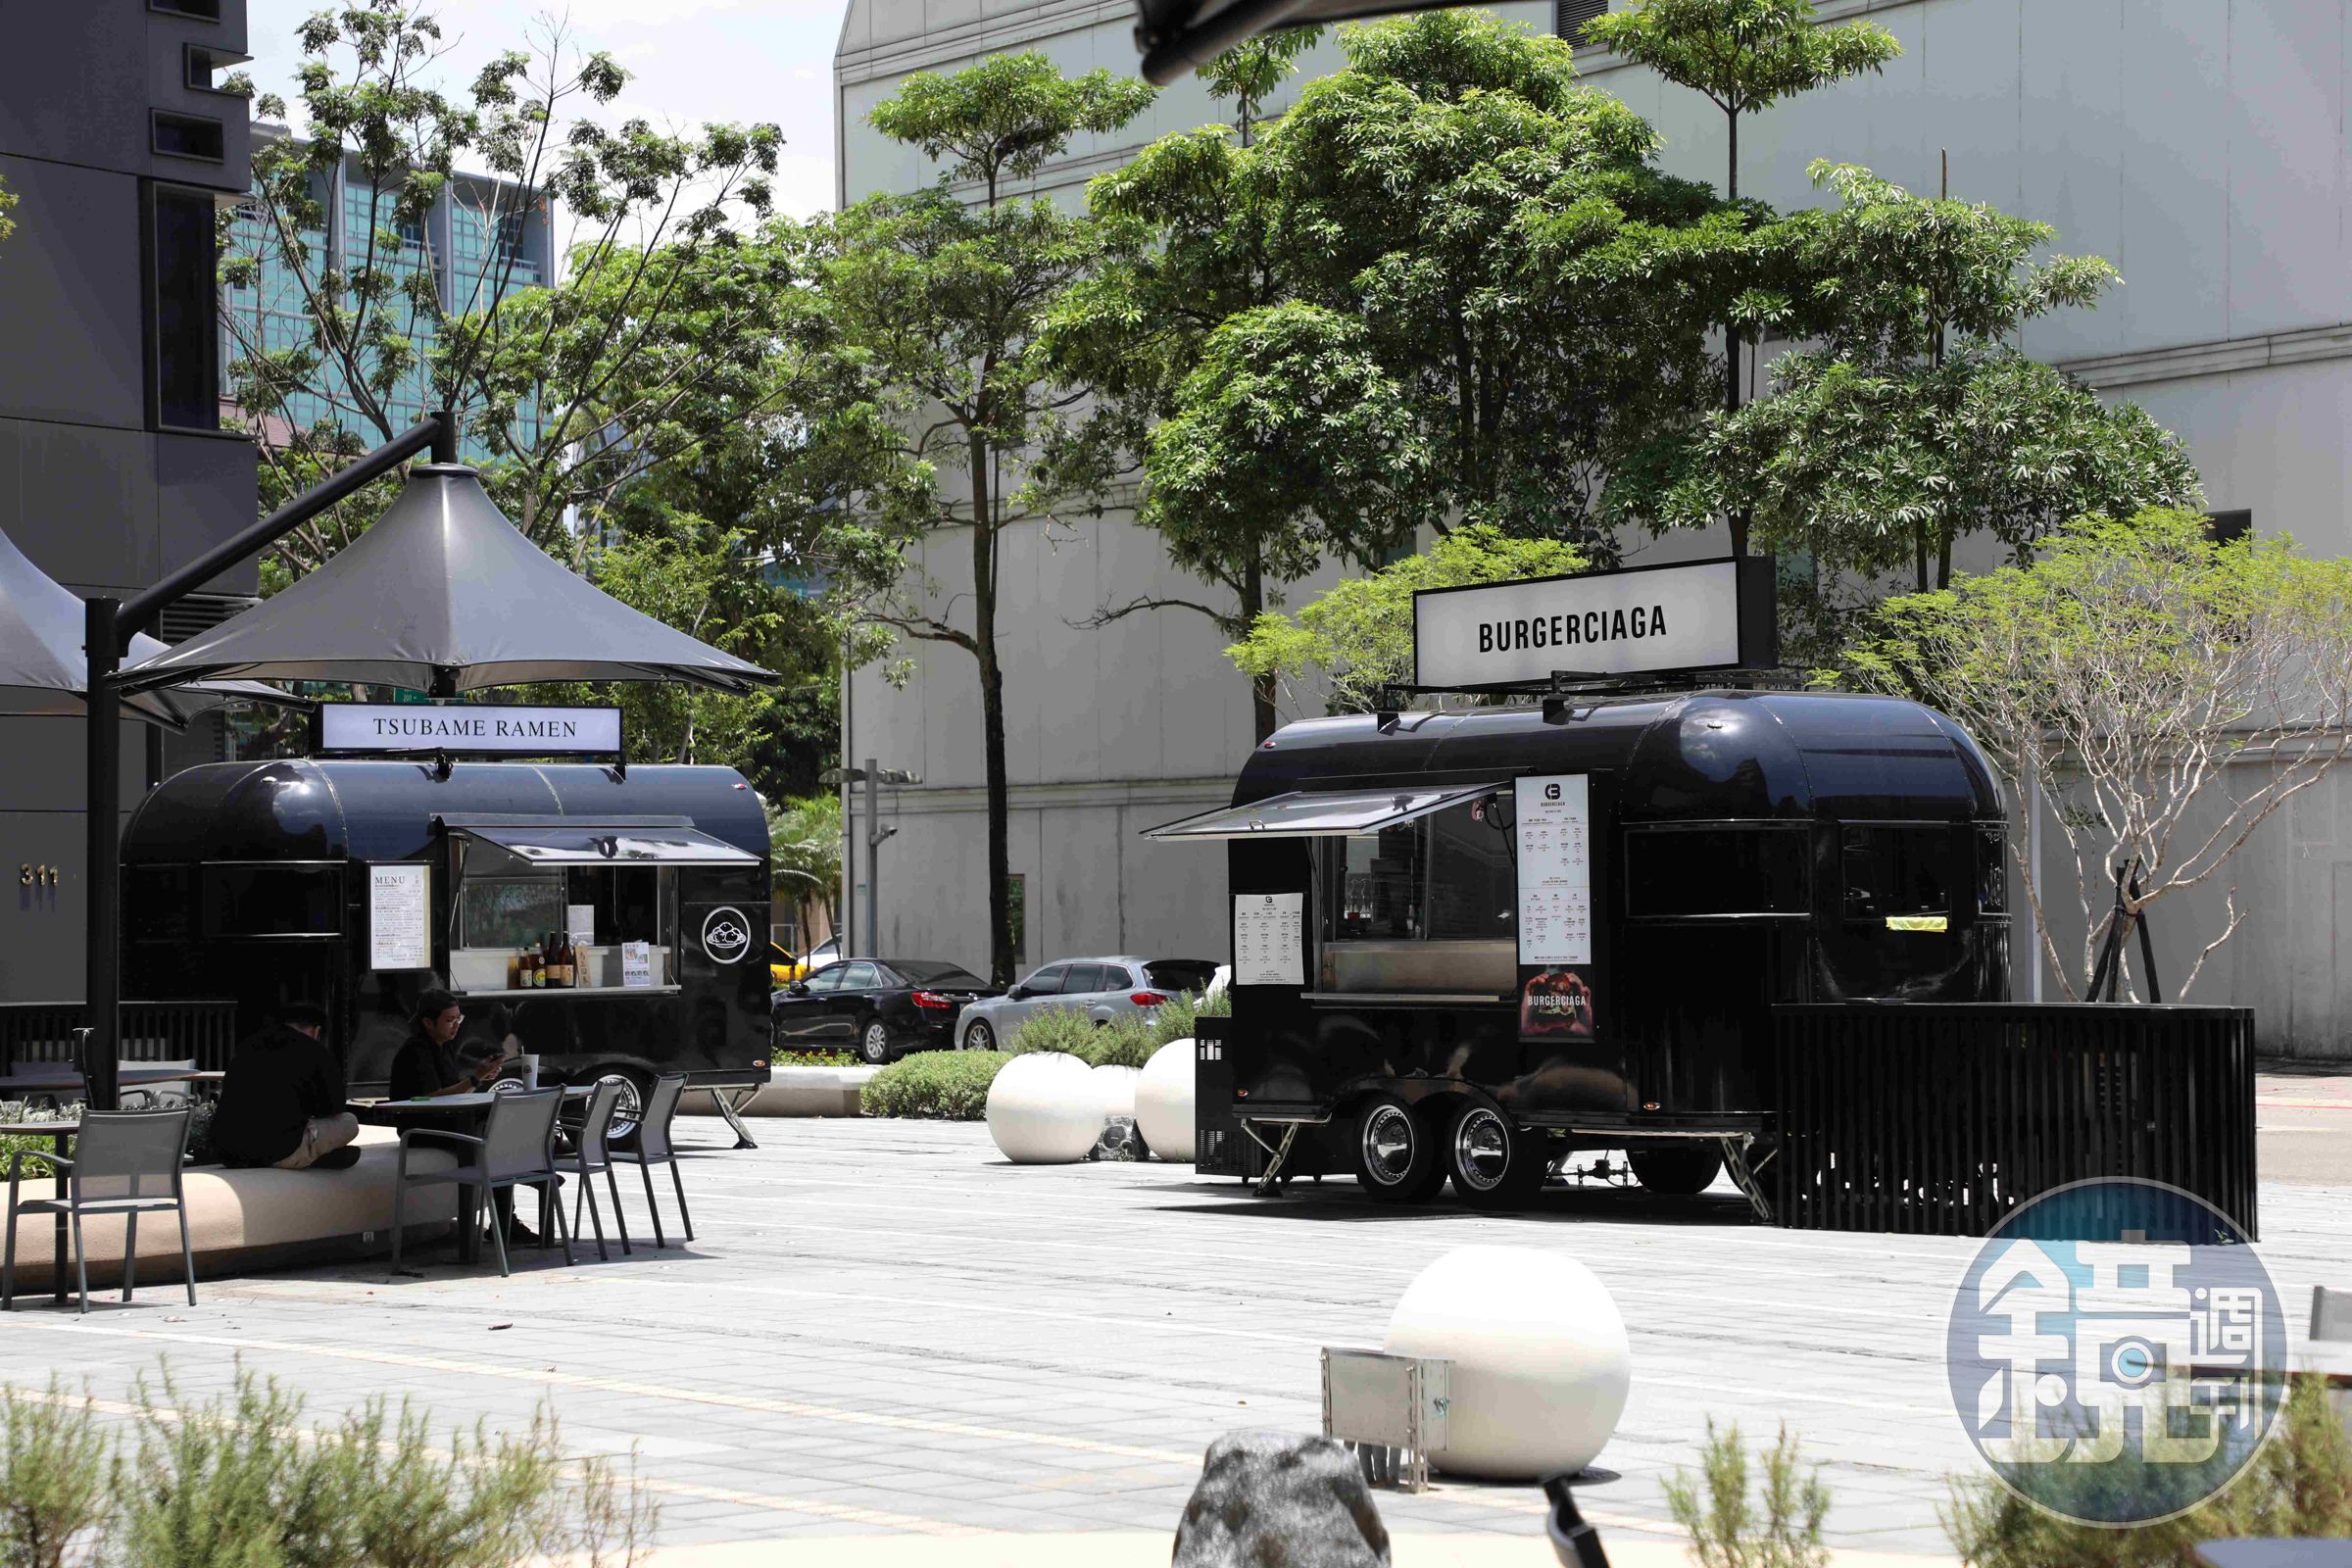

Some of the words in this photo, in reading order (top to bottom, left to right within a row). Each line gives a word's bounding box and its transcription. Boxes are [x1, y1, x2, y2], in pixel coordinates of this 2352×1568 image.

[1479, 605, 1667, 653] BURGERCIAGA
[372, 718, 486, 736] TSUBAME
[495, 720, 577, 737] RAMEN
[21, 863, 59, 886] 311
[1527, 995, 1587, 1006] BURGERCIAGA
